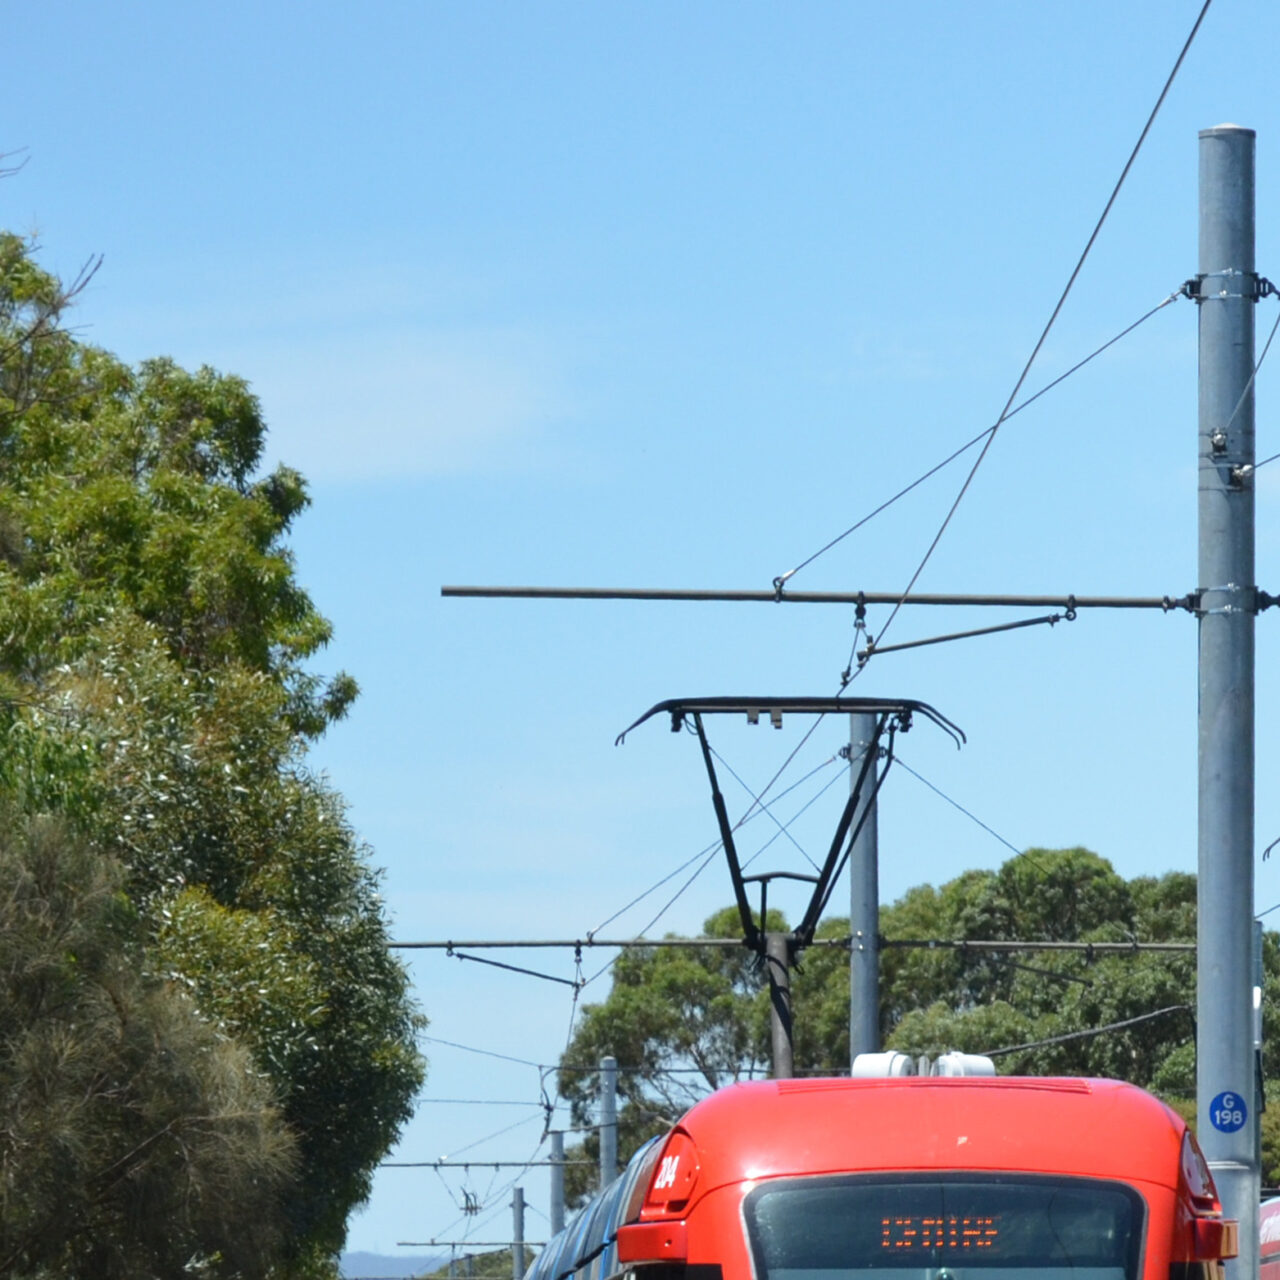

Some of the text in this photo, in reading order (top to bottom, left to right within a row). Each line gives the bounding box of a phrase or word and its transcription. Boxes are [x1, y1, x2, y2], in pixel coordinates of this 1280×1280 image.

[1222, 1094, 1235, 1109] G
[1215, 1110, 1243, 1125] 198
[654, 1155, 680, 1189] 204
